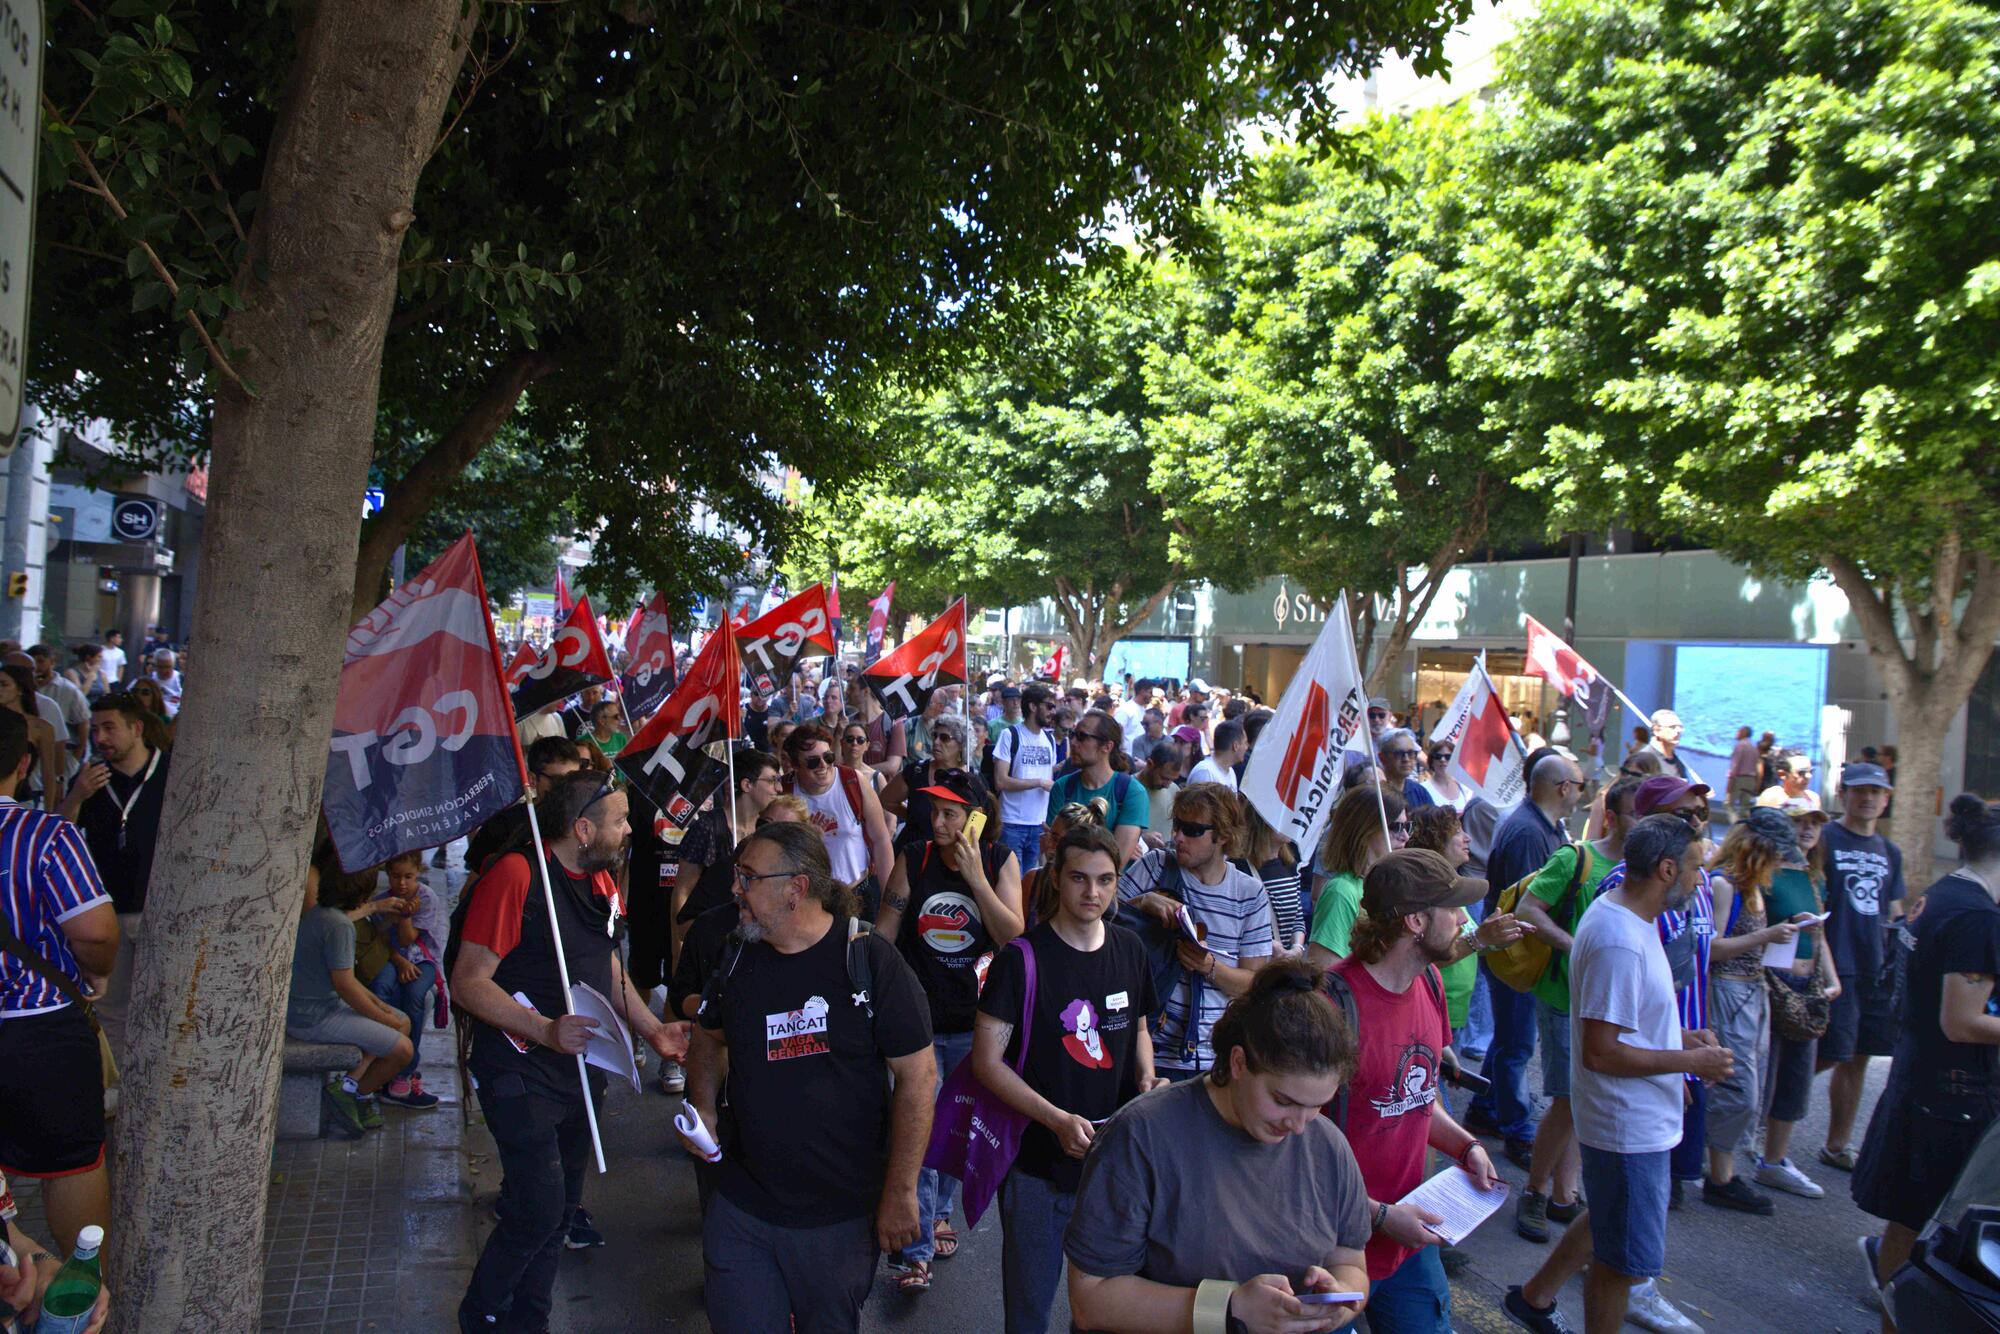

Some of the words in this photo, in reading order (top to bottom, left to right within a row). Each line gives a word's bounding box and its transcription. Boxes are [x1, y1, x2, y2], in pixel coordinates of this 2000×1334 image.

[122, 512, 147, 525] SH
[768, 1016, 826, 1036] TANCAT
[781, 1034, 815, 1048] VAGA
[769, 1042, 830, 1060] GENERAL
[971, 1116, 1000, 1149] GUALTAT
